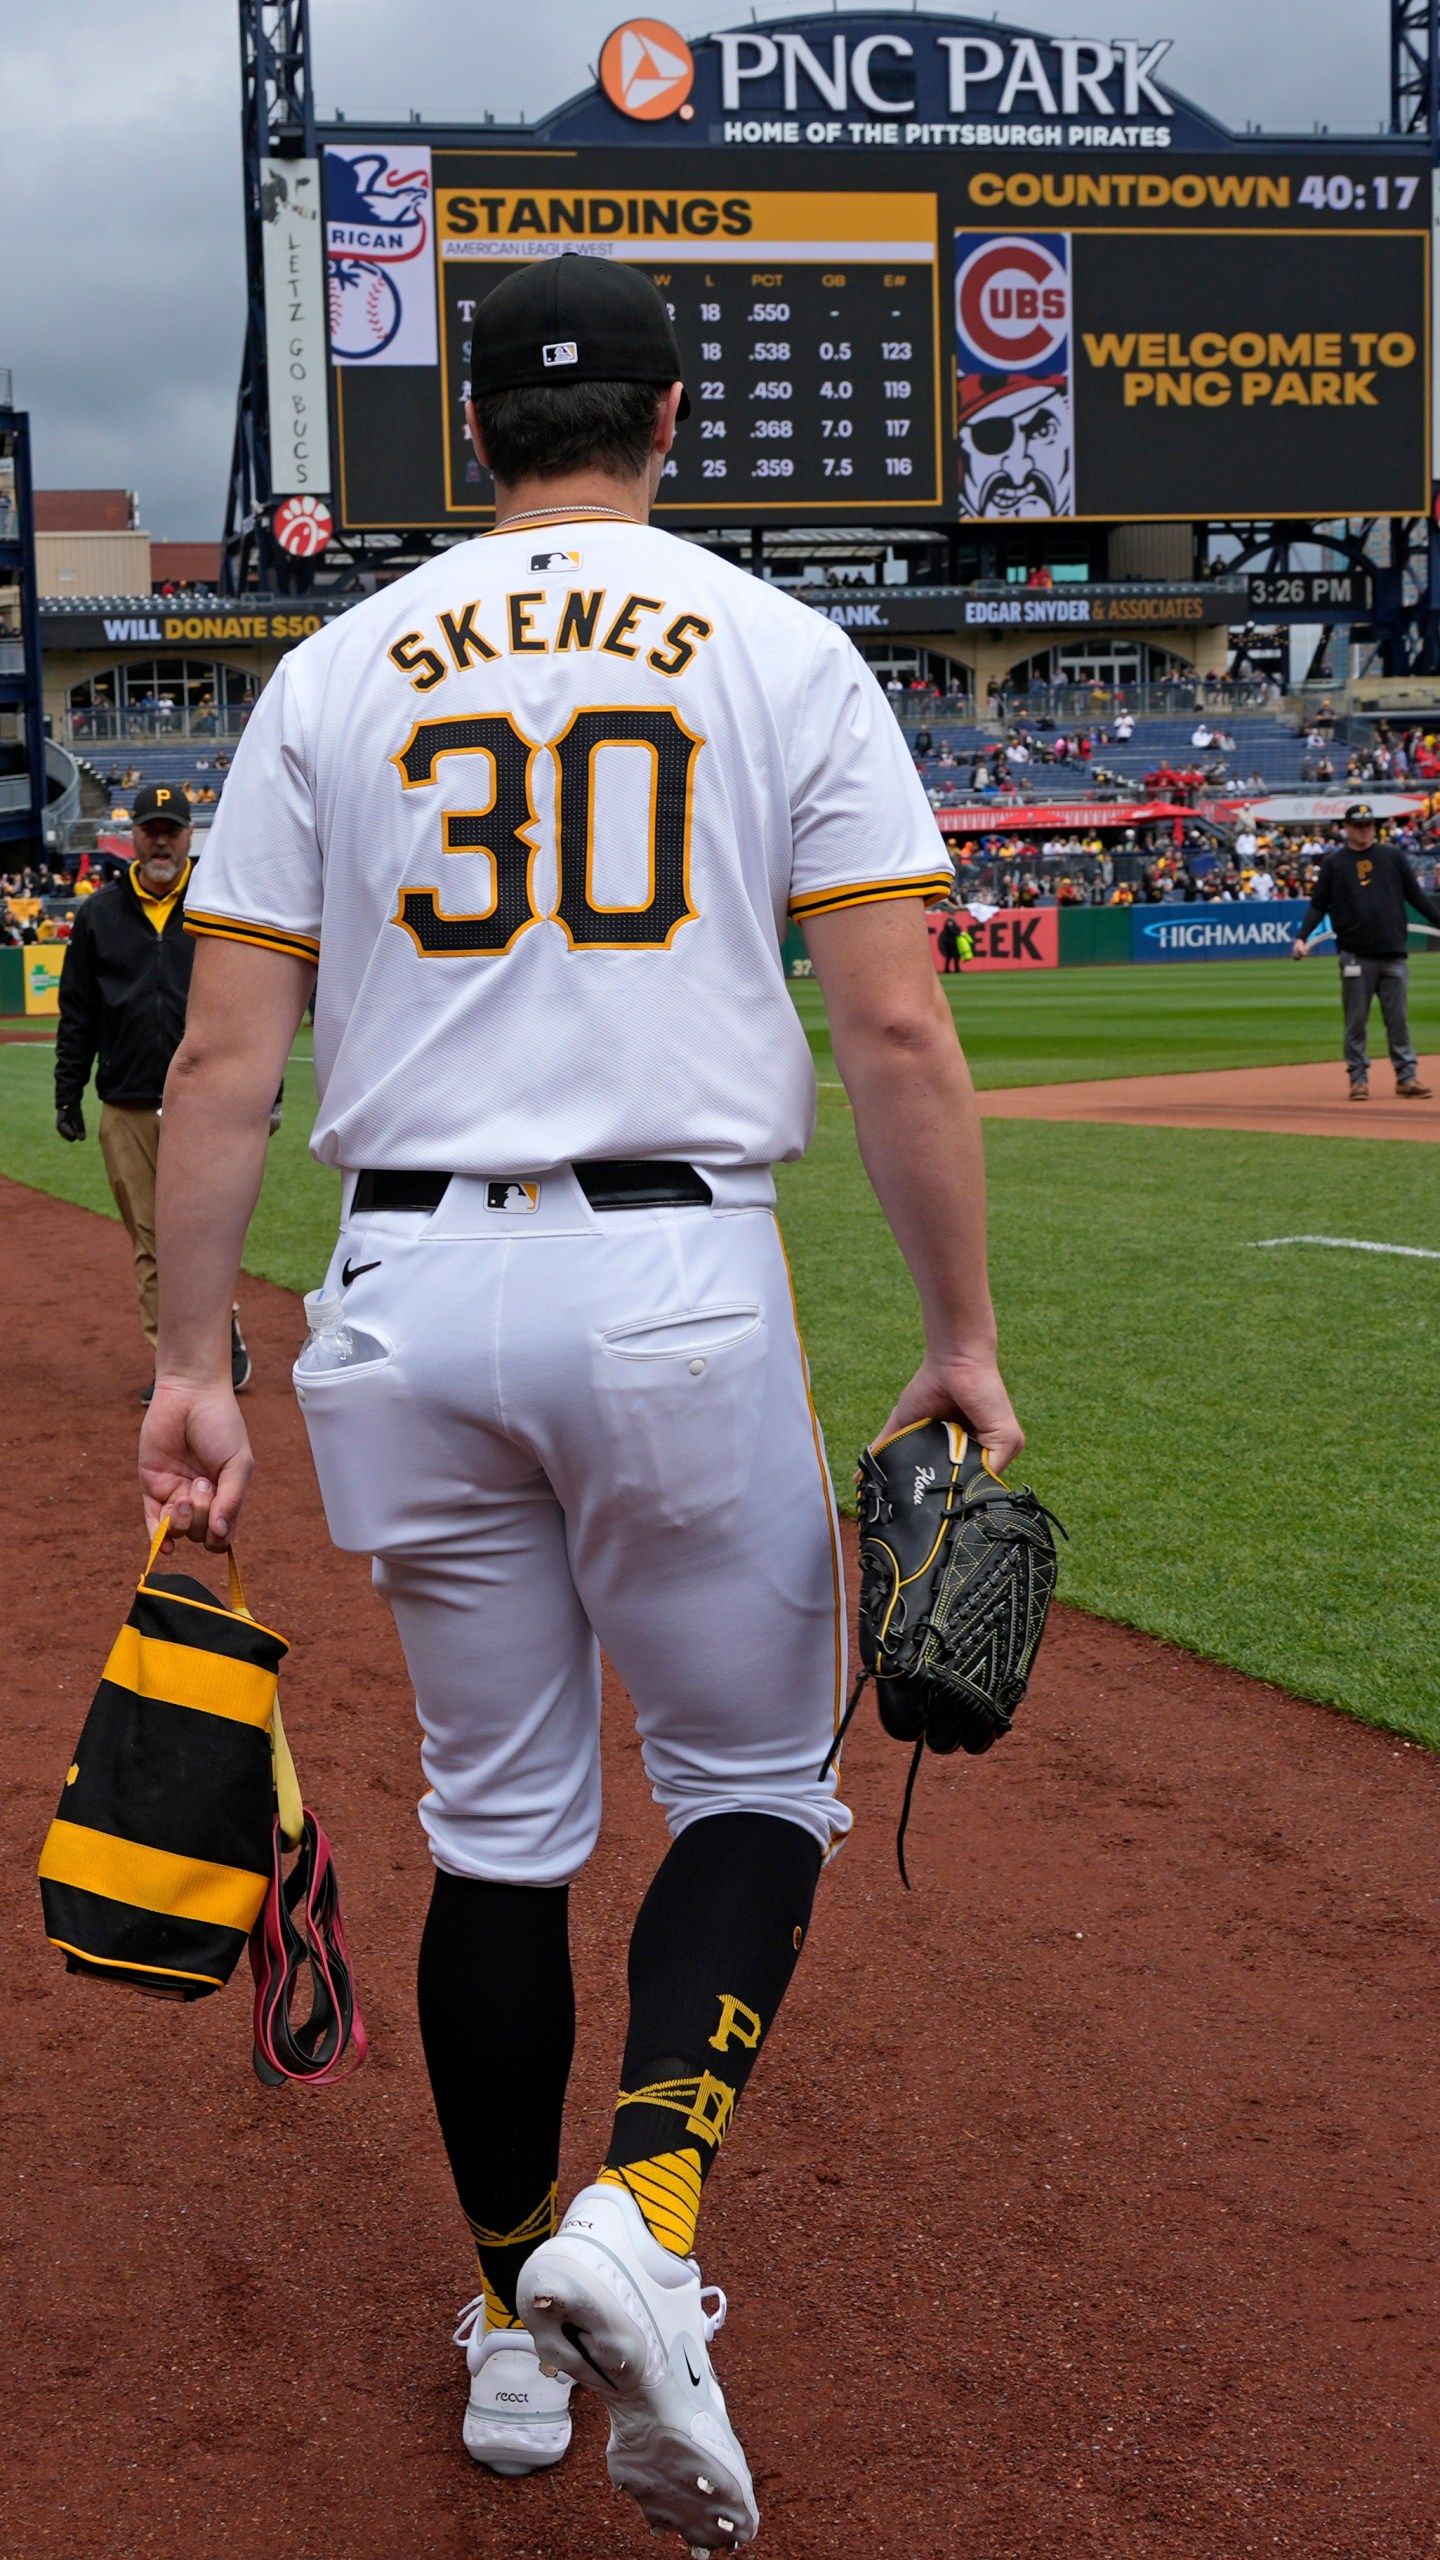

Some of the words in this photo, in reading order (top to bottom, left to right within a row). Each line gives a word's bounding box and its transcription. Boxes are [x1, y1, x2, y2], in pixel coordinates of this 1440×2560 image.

[713, 34, 915, 113] PNC
[937, 36, 1174, 116] PARK
[724, 122, 800, 144] HOME
[806, 123, 842, 145] OF
[848, 123, 899, 145] THE
[905, 123, 1062, 147] PITTSBURGH
[1069, 125, 1171, 148] PIRATES
[967, 172, 1291, 208] COUNTDOWN
[1297, 175, 1421, 211] 40:17
[446, 196, 753, 236] STANDINGS
[446, 242, 520, 256] AMERICAN
[522, 242, 573, 256] LEAGUE
[576, 242, 614, 257] WEST
[654, 274, 672, 287] W
[705, 275, 715, 287] L
[752, 275, 783, 288] PCT
[822, 275, 846, 288] GB
[884, 275, 906, 288] E#
[700, 304, 722, 322] 18
[747, 304, 791, 323] .550
[290, 338, 306, 380] GO
[701, 343, 723, 361] 18
[749, 343, 791, 361] .538
[819, 343, 852, 361] 0.5
[881, 343, 913, 361] 123
[1083, 333, 1342, 368] WELCOME
[1351, 333, 1416, 368] TO
[700, 382, 726, 400] 22
[749, 382, 793, 400] .450
[819, 382, 853, 400] 4.0
[884, 381, 912, 400] 119
[1123, 371, 1233, 408] PNC
[1241, 371, 1379, 406] PARK
[293, 394, 308, 484] BUCS
[701, 421, 727, 439] 24
[750, 421, 793, 439] .368
[821, 420, 853, 438] 7.0
[886, 420, 911, 438] 117
[702, 459, 728, 477] 25
[752, 459, 794, 477] .359
[823, 458, 854, 477] 7.5
[886, 458, 913, 476] 116
[1251, 580, 1305, 603] 3:26
[1312, 578, 1351, 602] PM
[965, 601, 1022, 624] EDGAR
[1025, 600, 1090, 622] SNYDER
[1094, 599, 1104, 620] &
[1108, 598, 1203, 619] ASSOCIATES
[104, 620, 162, 641] WILL
[165, 618, 267, 639] DONATE
[271, 615, 320, 638] $50
[388, 588, 713, 693] SKENES
[156, 789, 171, 807] P
[389, 705, 707, 958] 30
[1159, 921, 1291, 948] HIGHMARK
[792, 958, 814, 976] 37
